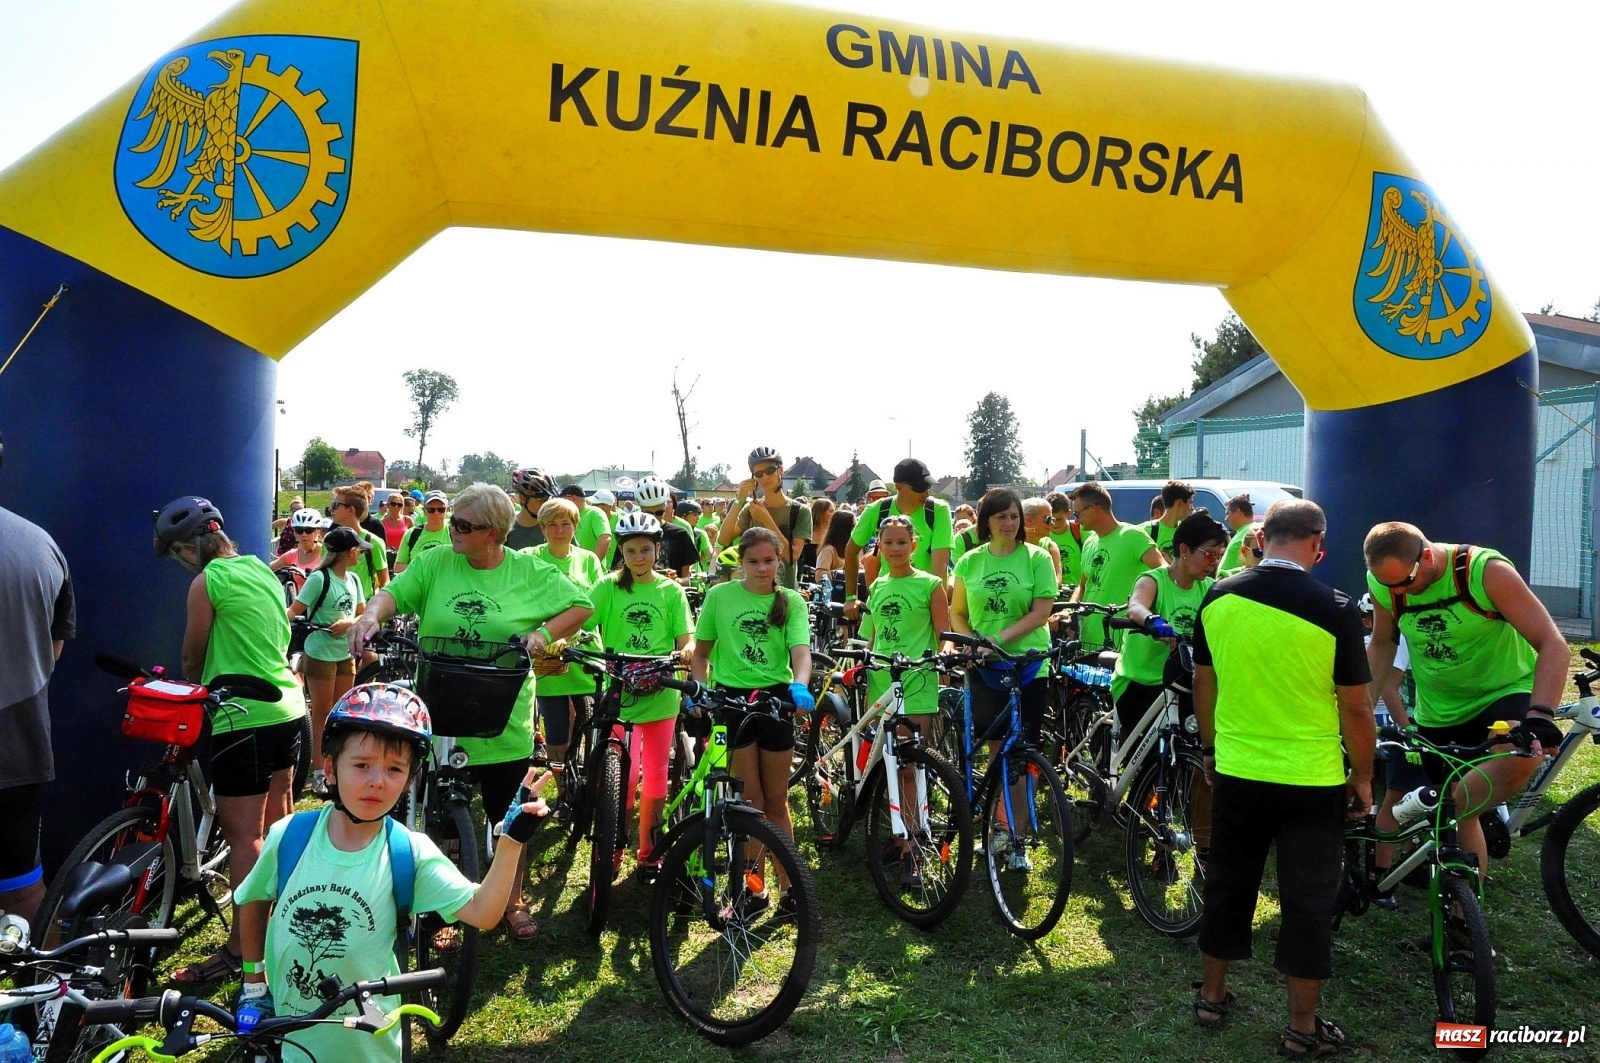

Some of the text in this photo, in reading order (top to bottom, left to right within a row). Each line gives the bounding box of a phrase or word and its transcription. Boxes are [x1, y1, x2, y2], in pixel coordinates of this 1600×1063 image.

[826, 24, 1041, 95] GMINA
[549, 62, 1244, 203] KUŹNIA RACIBORSKA
[1131, 727, 1157, 765] CROSSWIND
[281, 883, 375, 932] XXI Rodzinny Rajd Rowerowy
